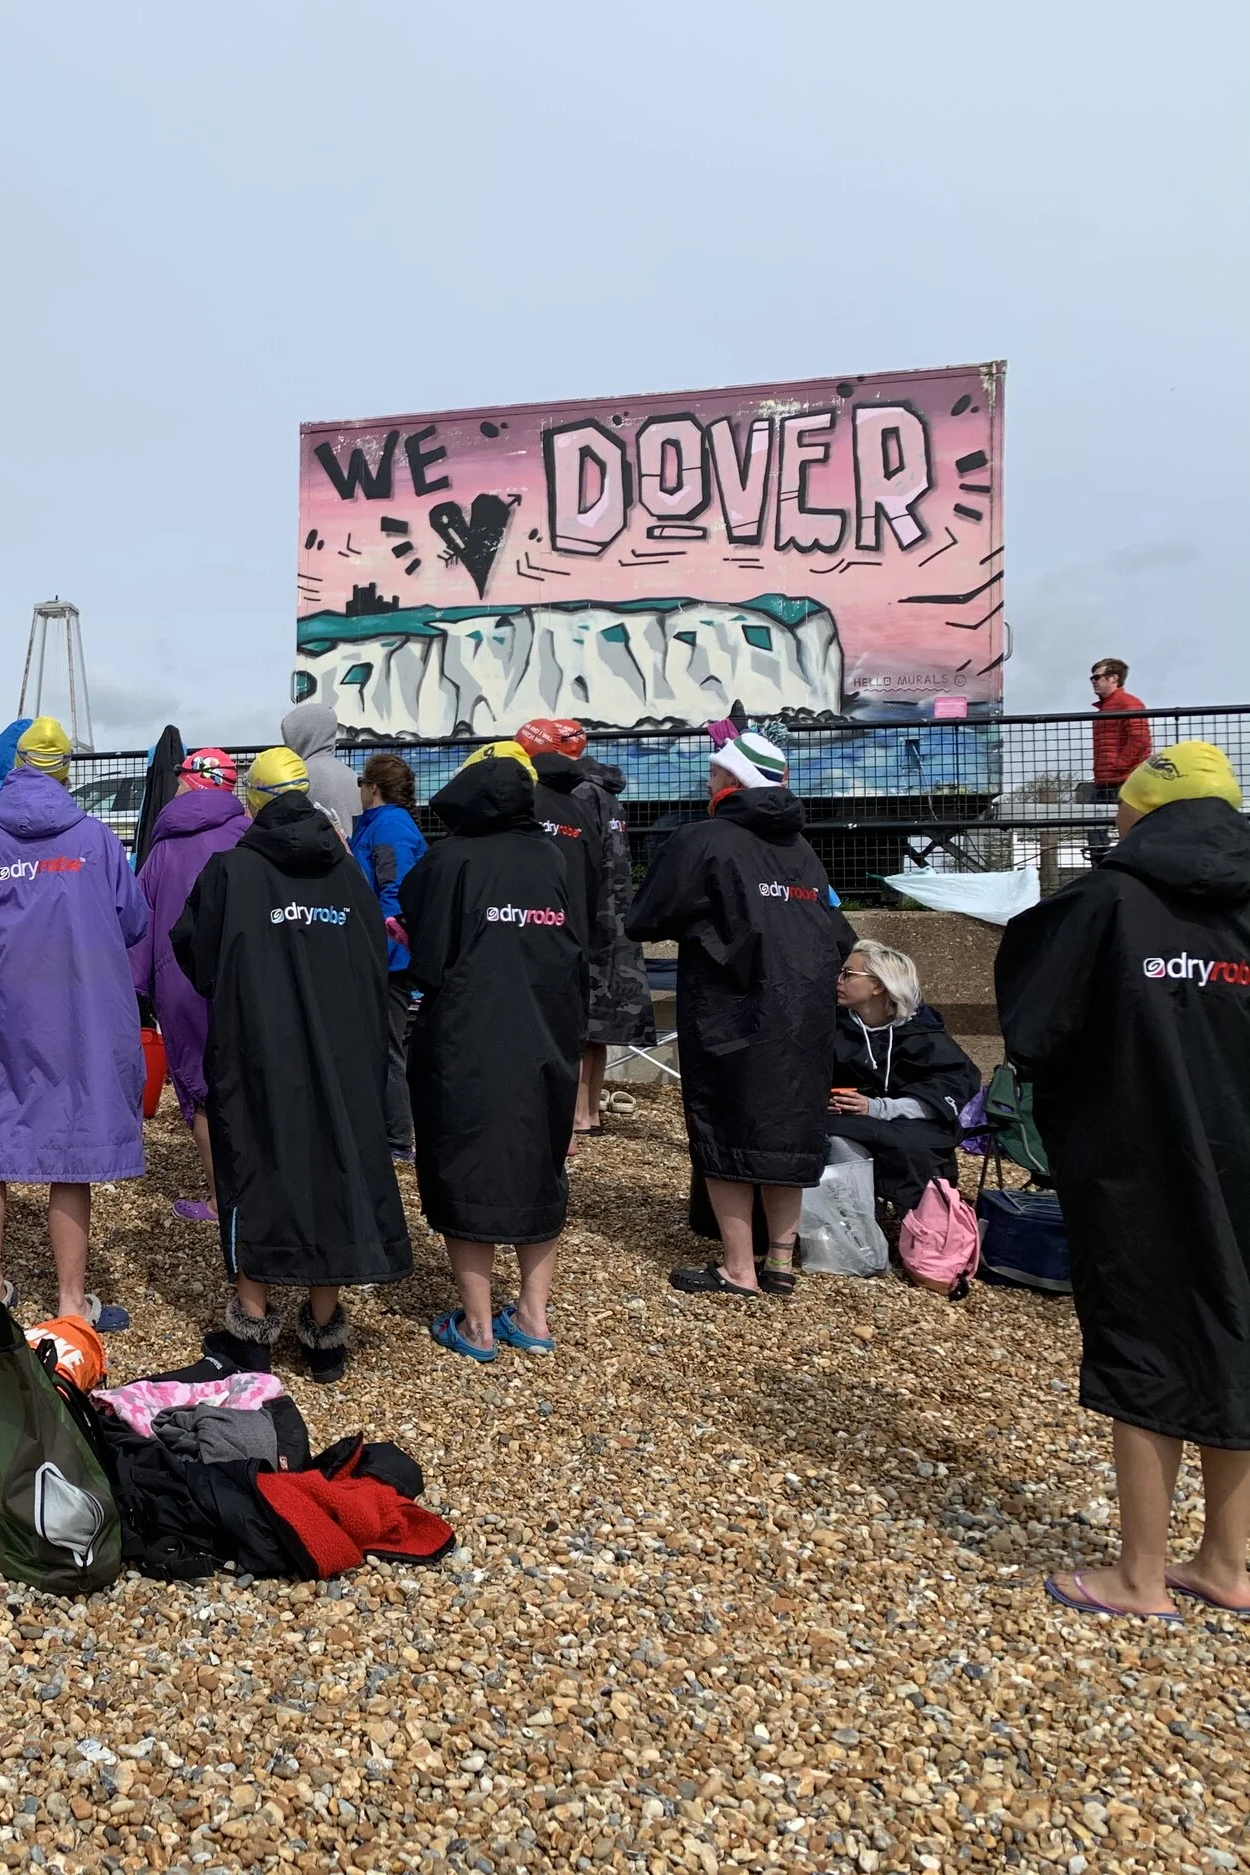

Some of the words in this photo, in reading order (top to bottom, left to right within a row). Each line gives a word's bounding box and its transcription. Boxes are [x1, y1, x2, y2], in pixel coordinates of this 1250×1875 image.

[314, 425, 450, 500] WE
[543, 401, 932, 557] DOVER
[853, 676, 891, 687] HELLO
[897, 674, 949, 685] MURALS
[10, 856, 83, 880] dryrobe
[284, 902, 346, 925] dryrobe
[500, 904, 565, 927] dryrobe
